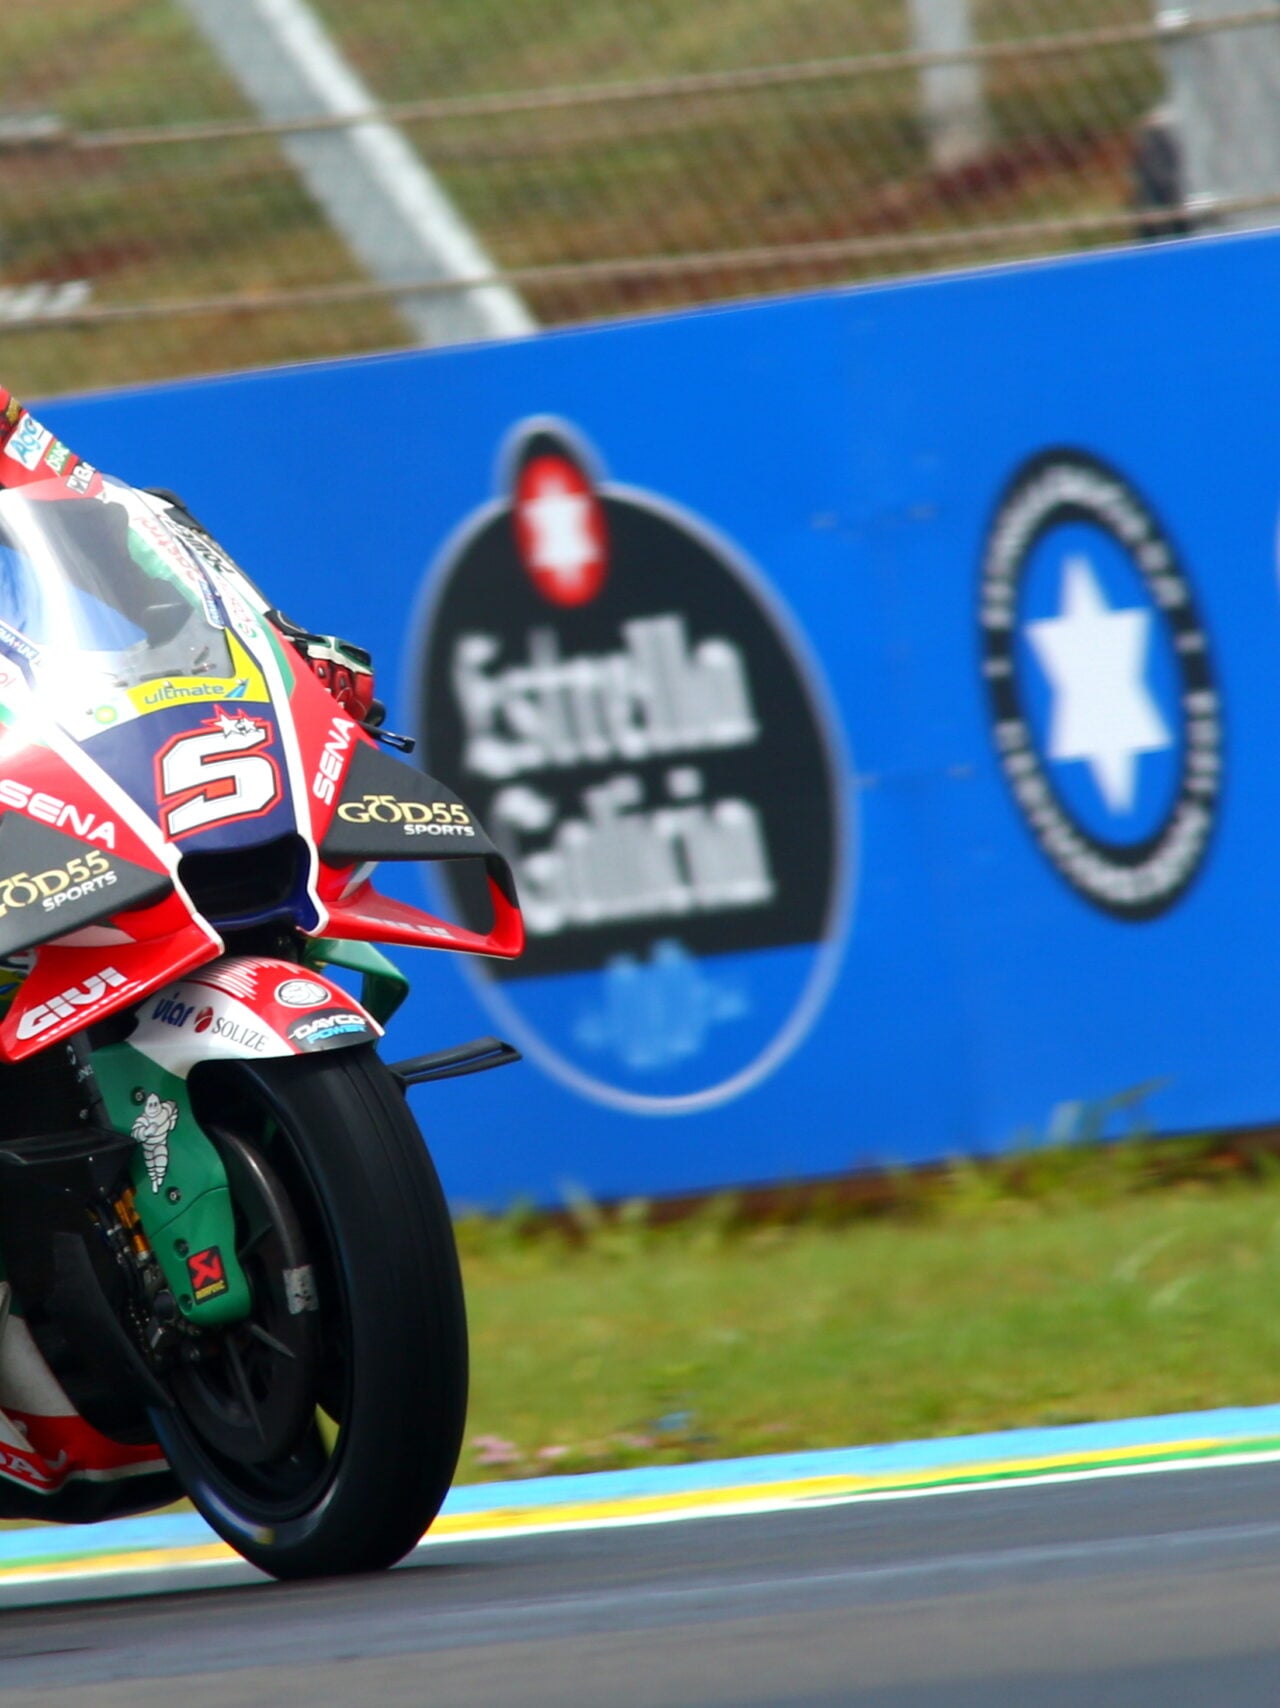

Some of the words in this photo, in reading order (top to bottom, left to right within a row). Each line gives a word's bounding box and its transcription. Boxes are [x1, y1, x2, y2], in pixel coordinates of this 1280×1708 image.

[154, 722, 283, 842] 5
[313, 717, 356, 806] SENA
[404, 824, 475, 837] SPORTS
[42, 870, 118, 912] SPORTS
[16, 966, 128, 1040] GIVI
[212, 1016, 268, 1052] SOLIZE
[308, 1024, 366, 1044] POWER
